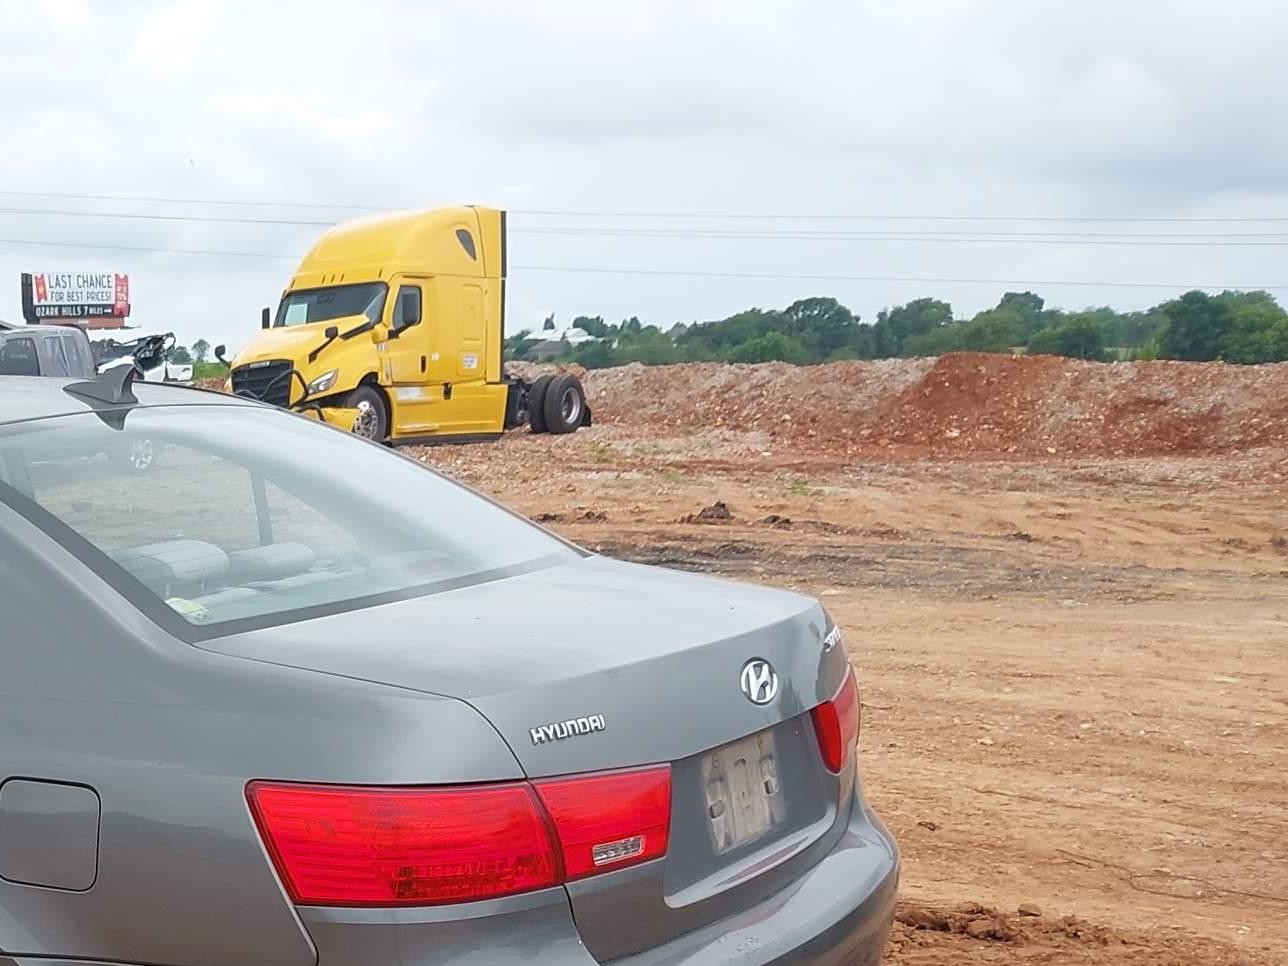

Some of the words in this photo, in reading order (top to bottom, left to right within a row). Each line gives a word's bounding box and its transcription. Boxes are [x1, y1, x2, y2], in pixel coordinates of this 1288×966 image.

[48, 274, 72, 288] LAST
[77, 274, 112, 288] CHANCE
[50, 291, 65, 302] FOR
[67, 291, 84, 302] BEST
[87, 291, 111, 302] PRICES!
[36, 306, 58, 316] OZARK
[62, 306, 82, 316] HILLS
[84, 306, 88, 316] 7
[530, 714, 605, 745] HYUNDAI
